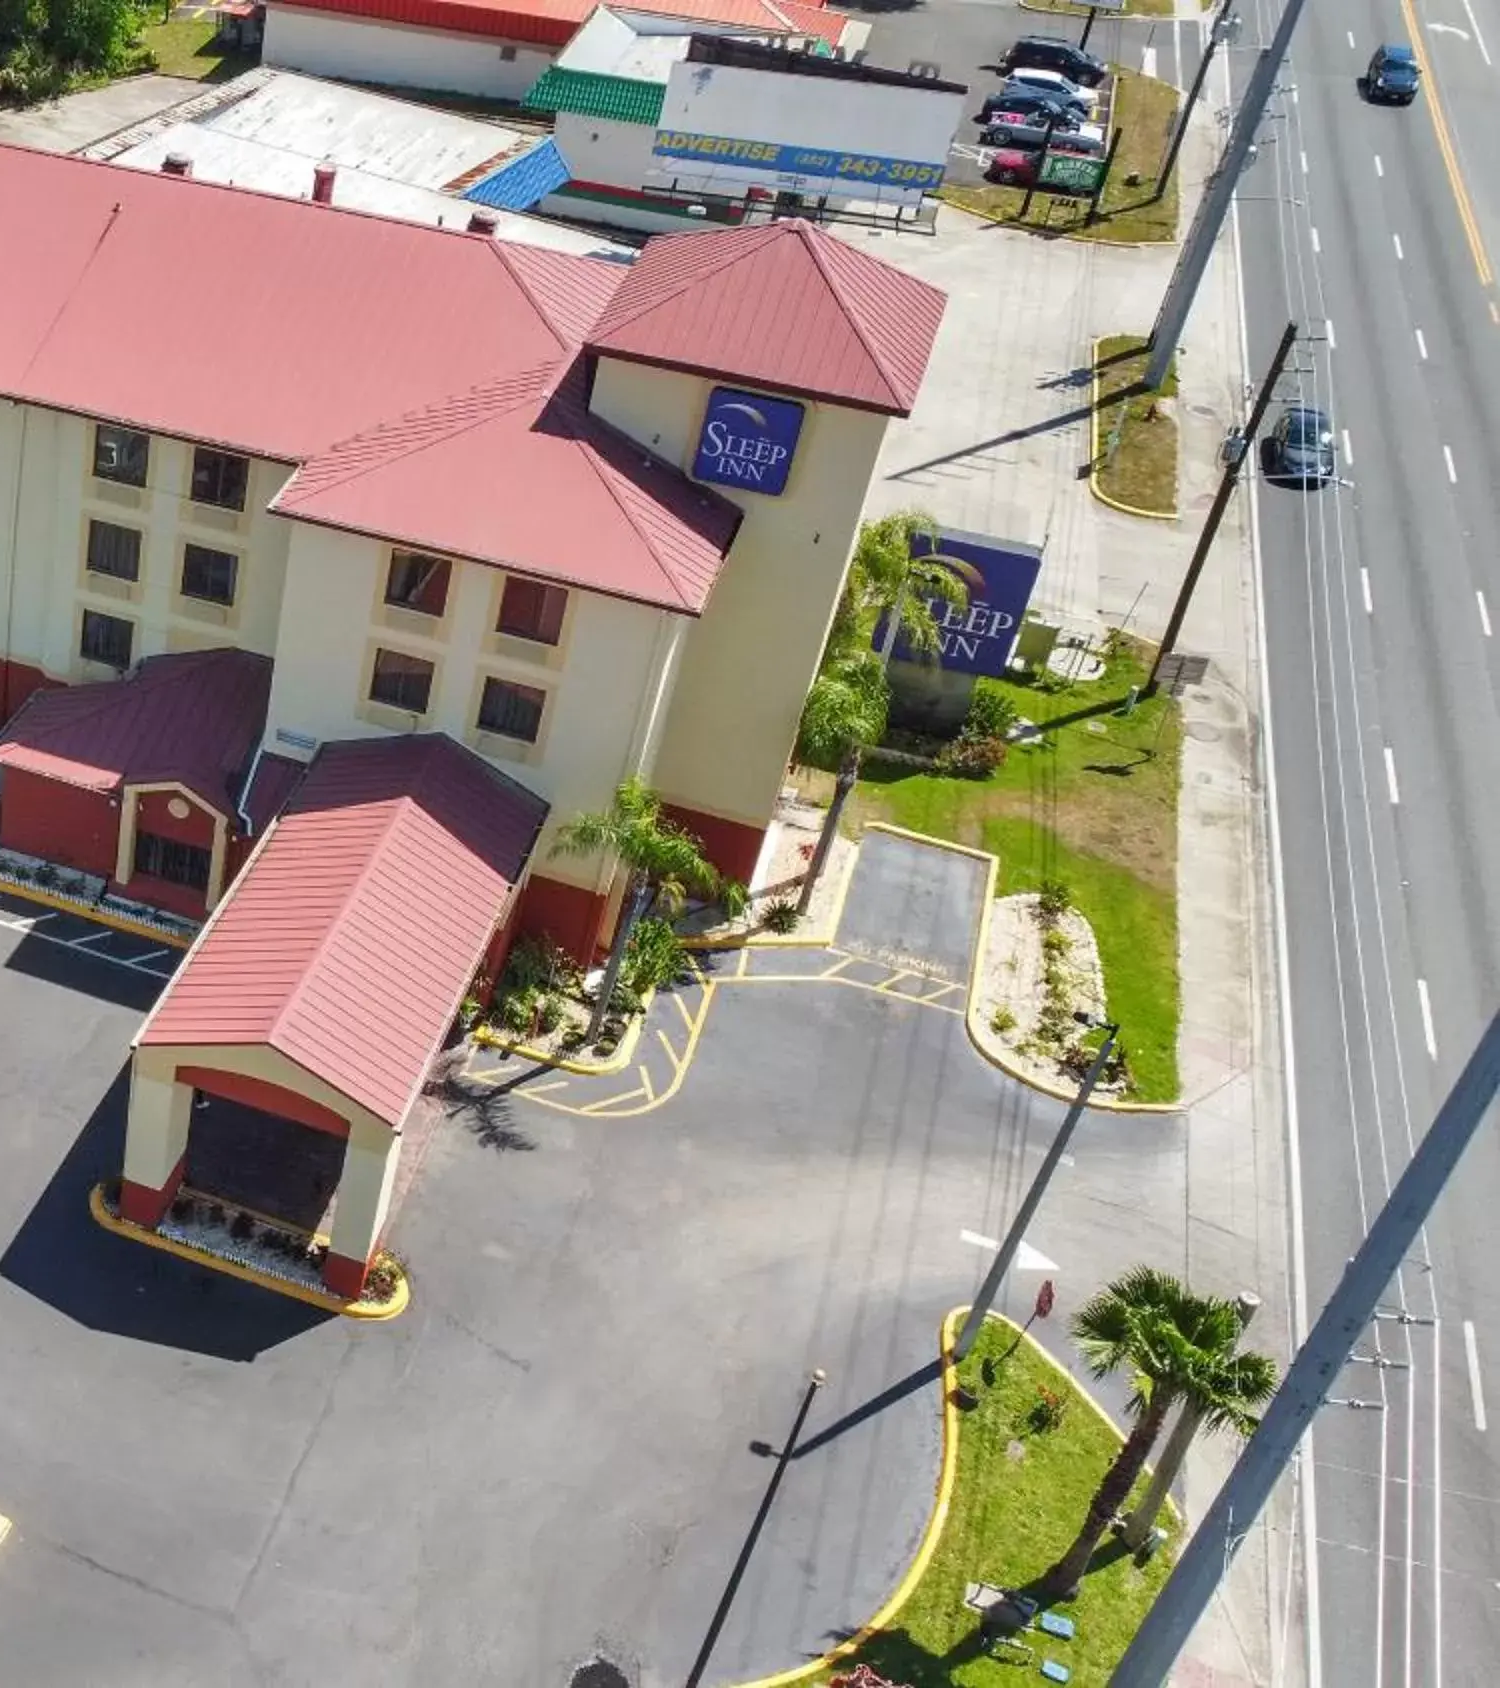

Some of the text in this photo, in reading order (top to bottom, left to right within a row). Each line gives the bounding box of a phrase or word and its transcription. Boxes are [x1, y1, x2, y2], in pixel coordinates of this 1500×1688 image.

[659, 133, 778, 162] ADVERTISE
[839, 156, 942, 183] 343-3951
[717, 456, 766, 481] INN
